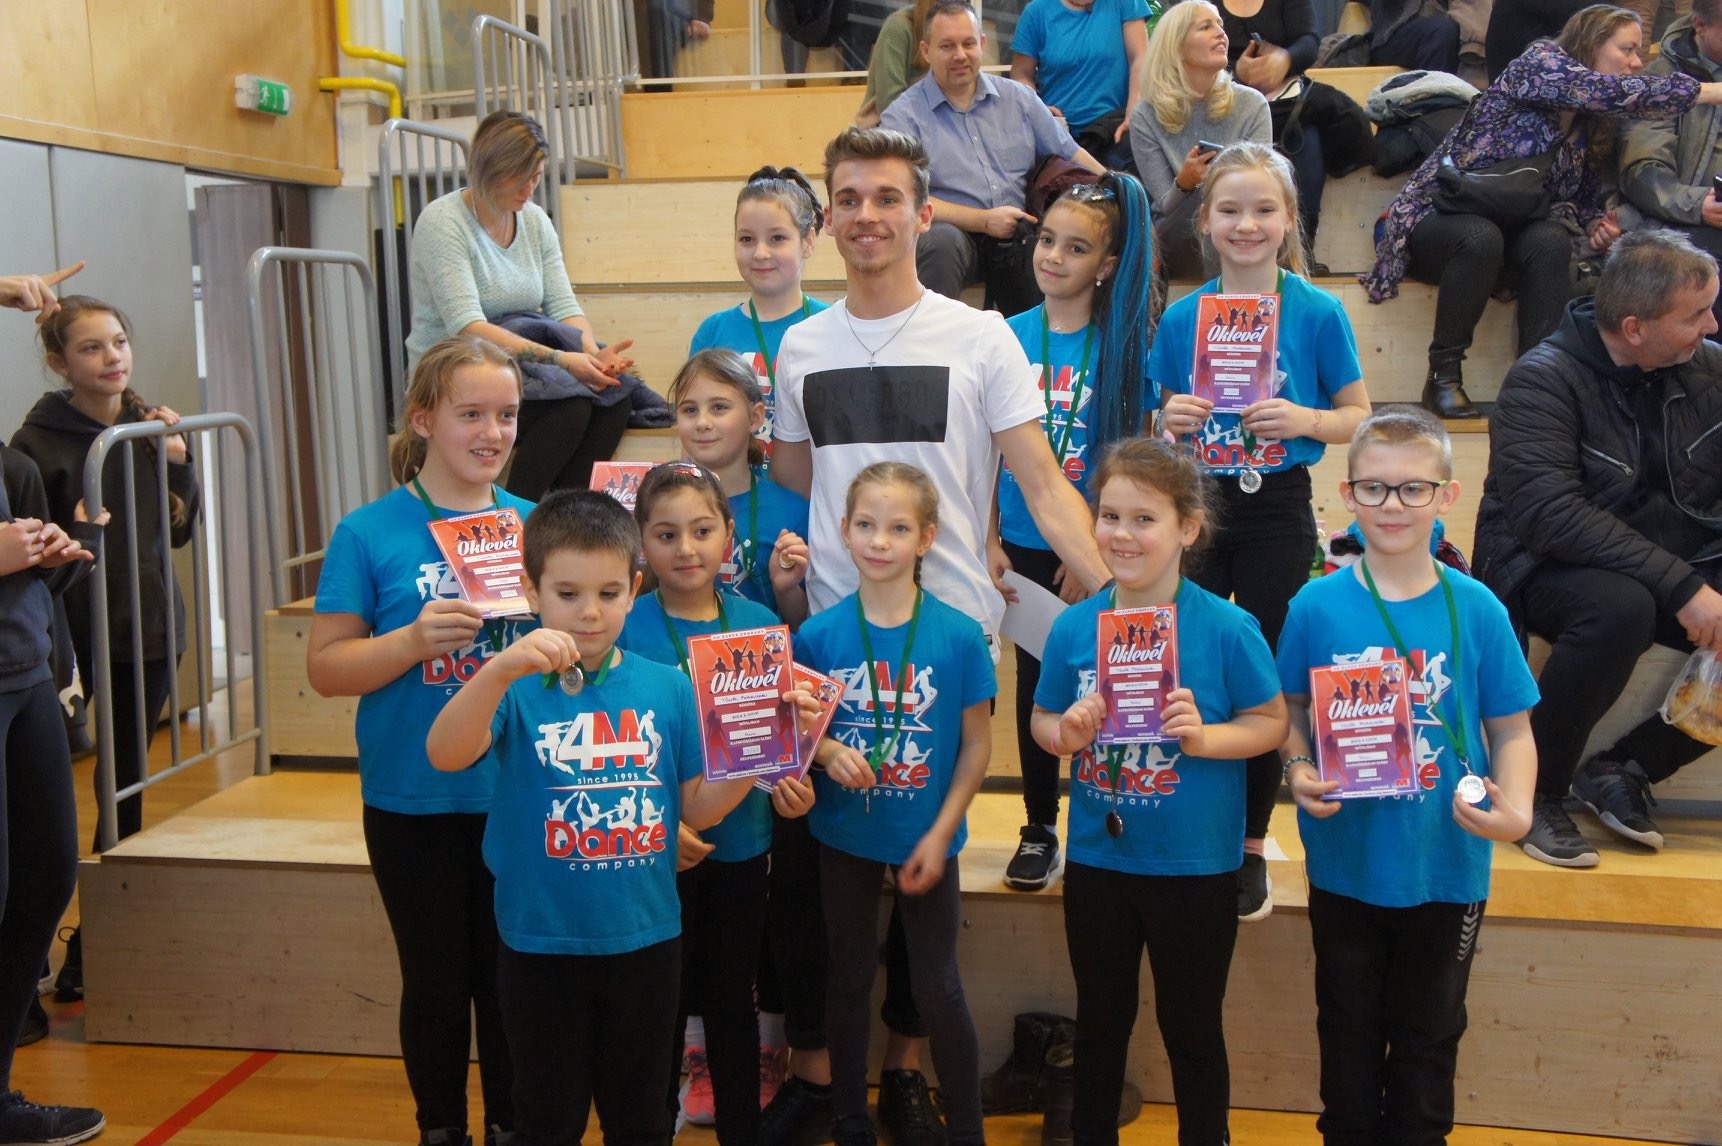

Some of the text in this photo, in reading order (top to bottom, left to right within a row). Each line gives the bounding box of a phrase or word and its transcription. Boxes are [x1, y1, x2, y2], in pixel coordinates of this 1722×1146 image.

[1207, 325, 1269, 343] Oklevél
[457, 534, 519, 557] Oklevél
[1107, 641, 1167, 664] Oklevél
[711, 665, 782, 694] Oklevél
[842, 661, 920, 714] 4M
[1328, 694, 1399, 720] Oklevél
[557, 709, 650, 770] 4M
[577, 772, 639, 785] since 1995
[1078, 750, 1180, 795] Dance
[1087, 789, 1161, 808] company
[545, 820, 667, 858] Dance
[569, 857, 655, 871] company
